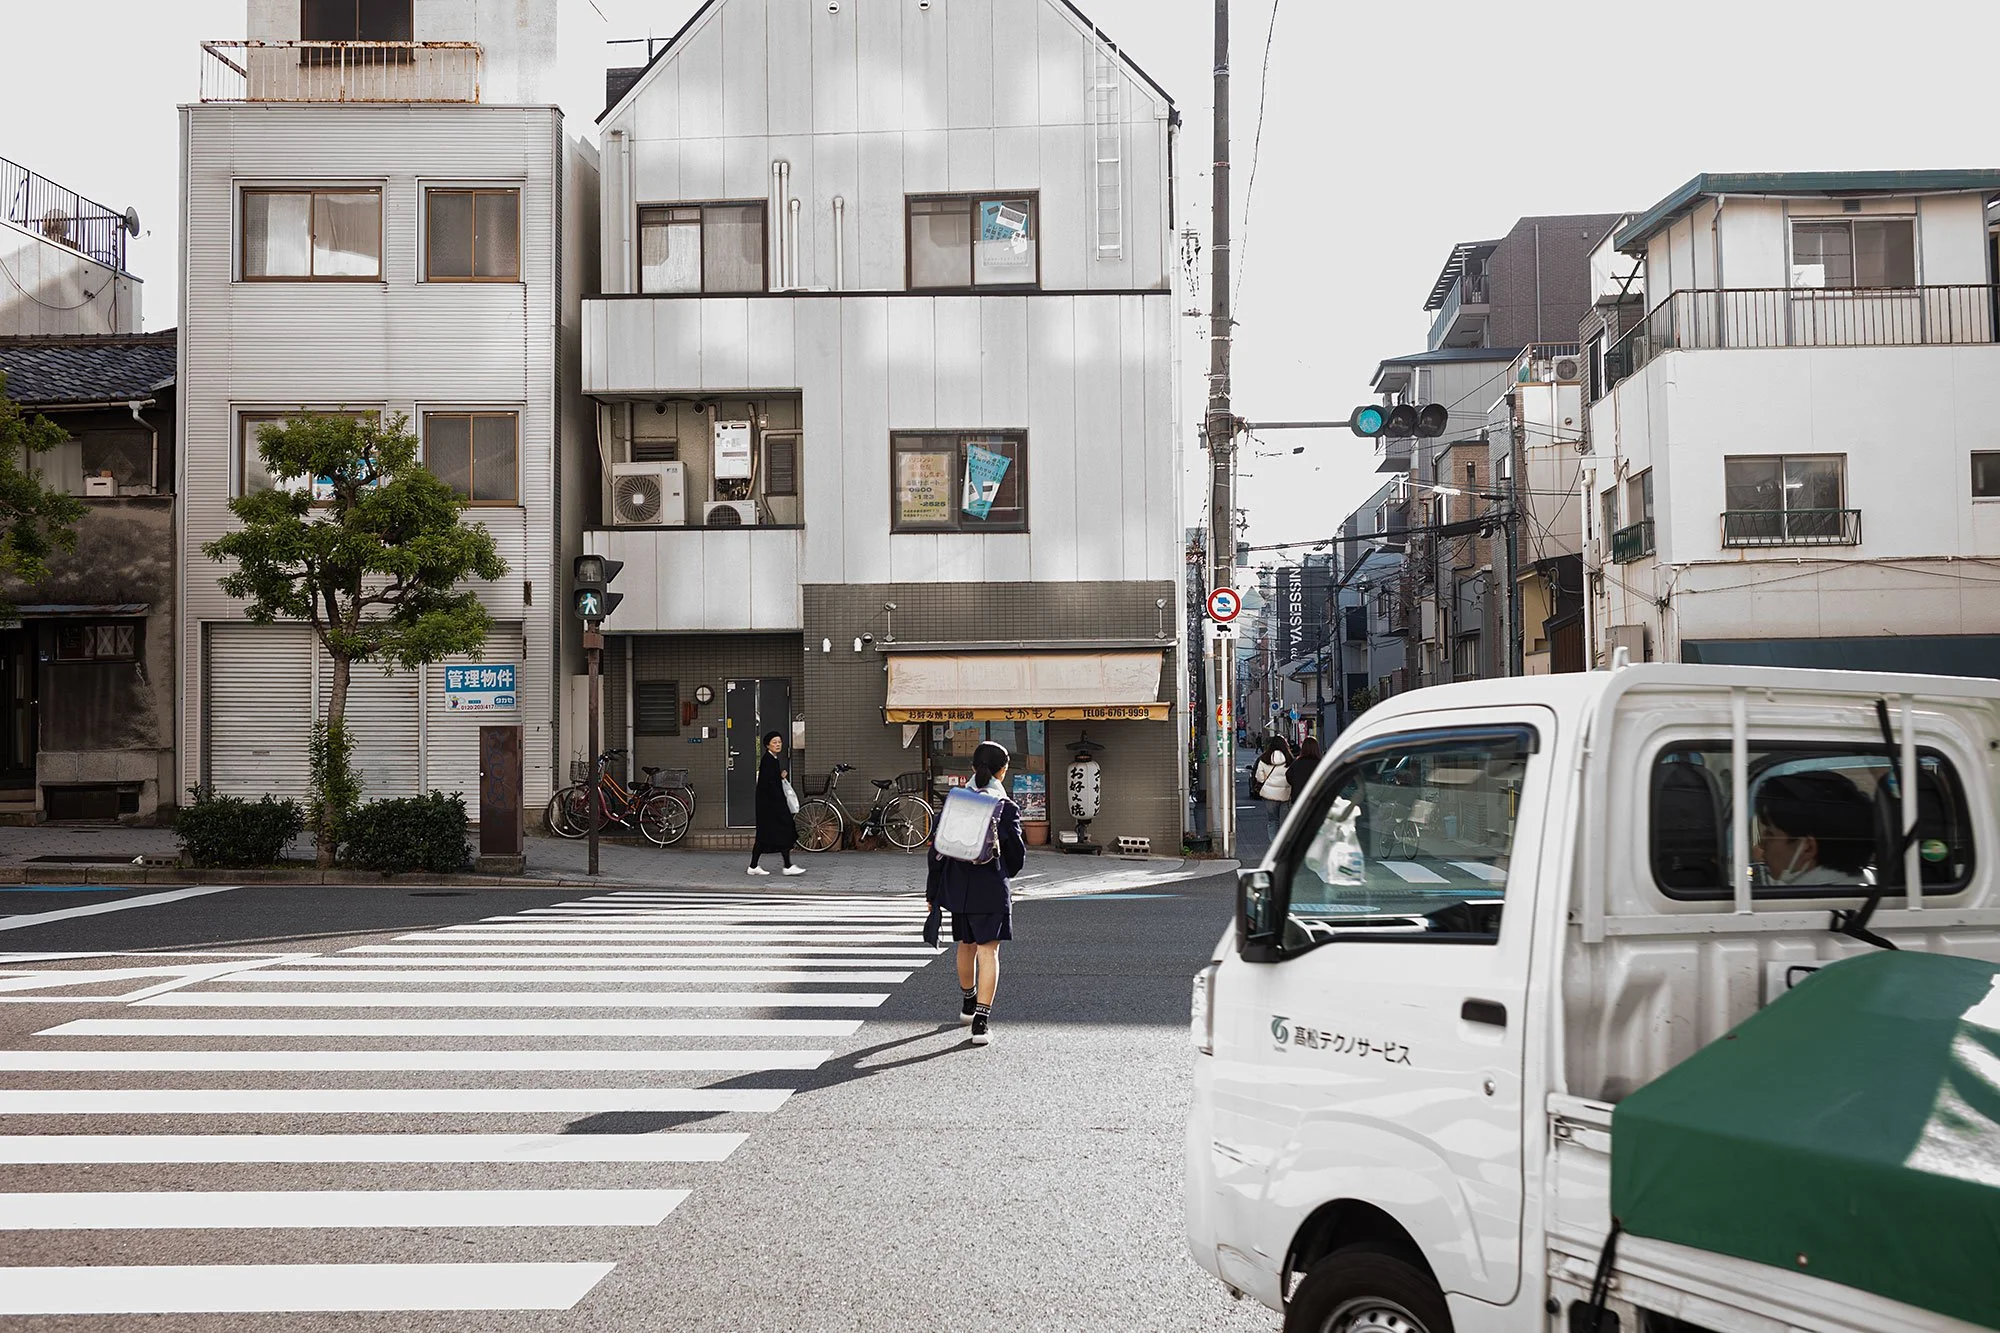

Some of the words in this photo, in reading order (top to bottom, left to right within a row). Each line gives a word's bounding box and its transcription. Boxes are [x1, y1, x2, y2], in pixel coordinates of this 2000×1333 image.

[448, 669, 513, 688] 管理物件
[1003, 707, 1056, 719] さかもと
